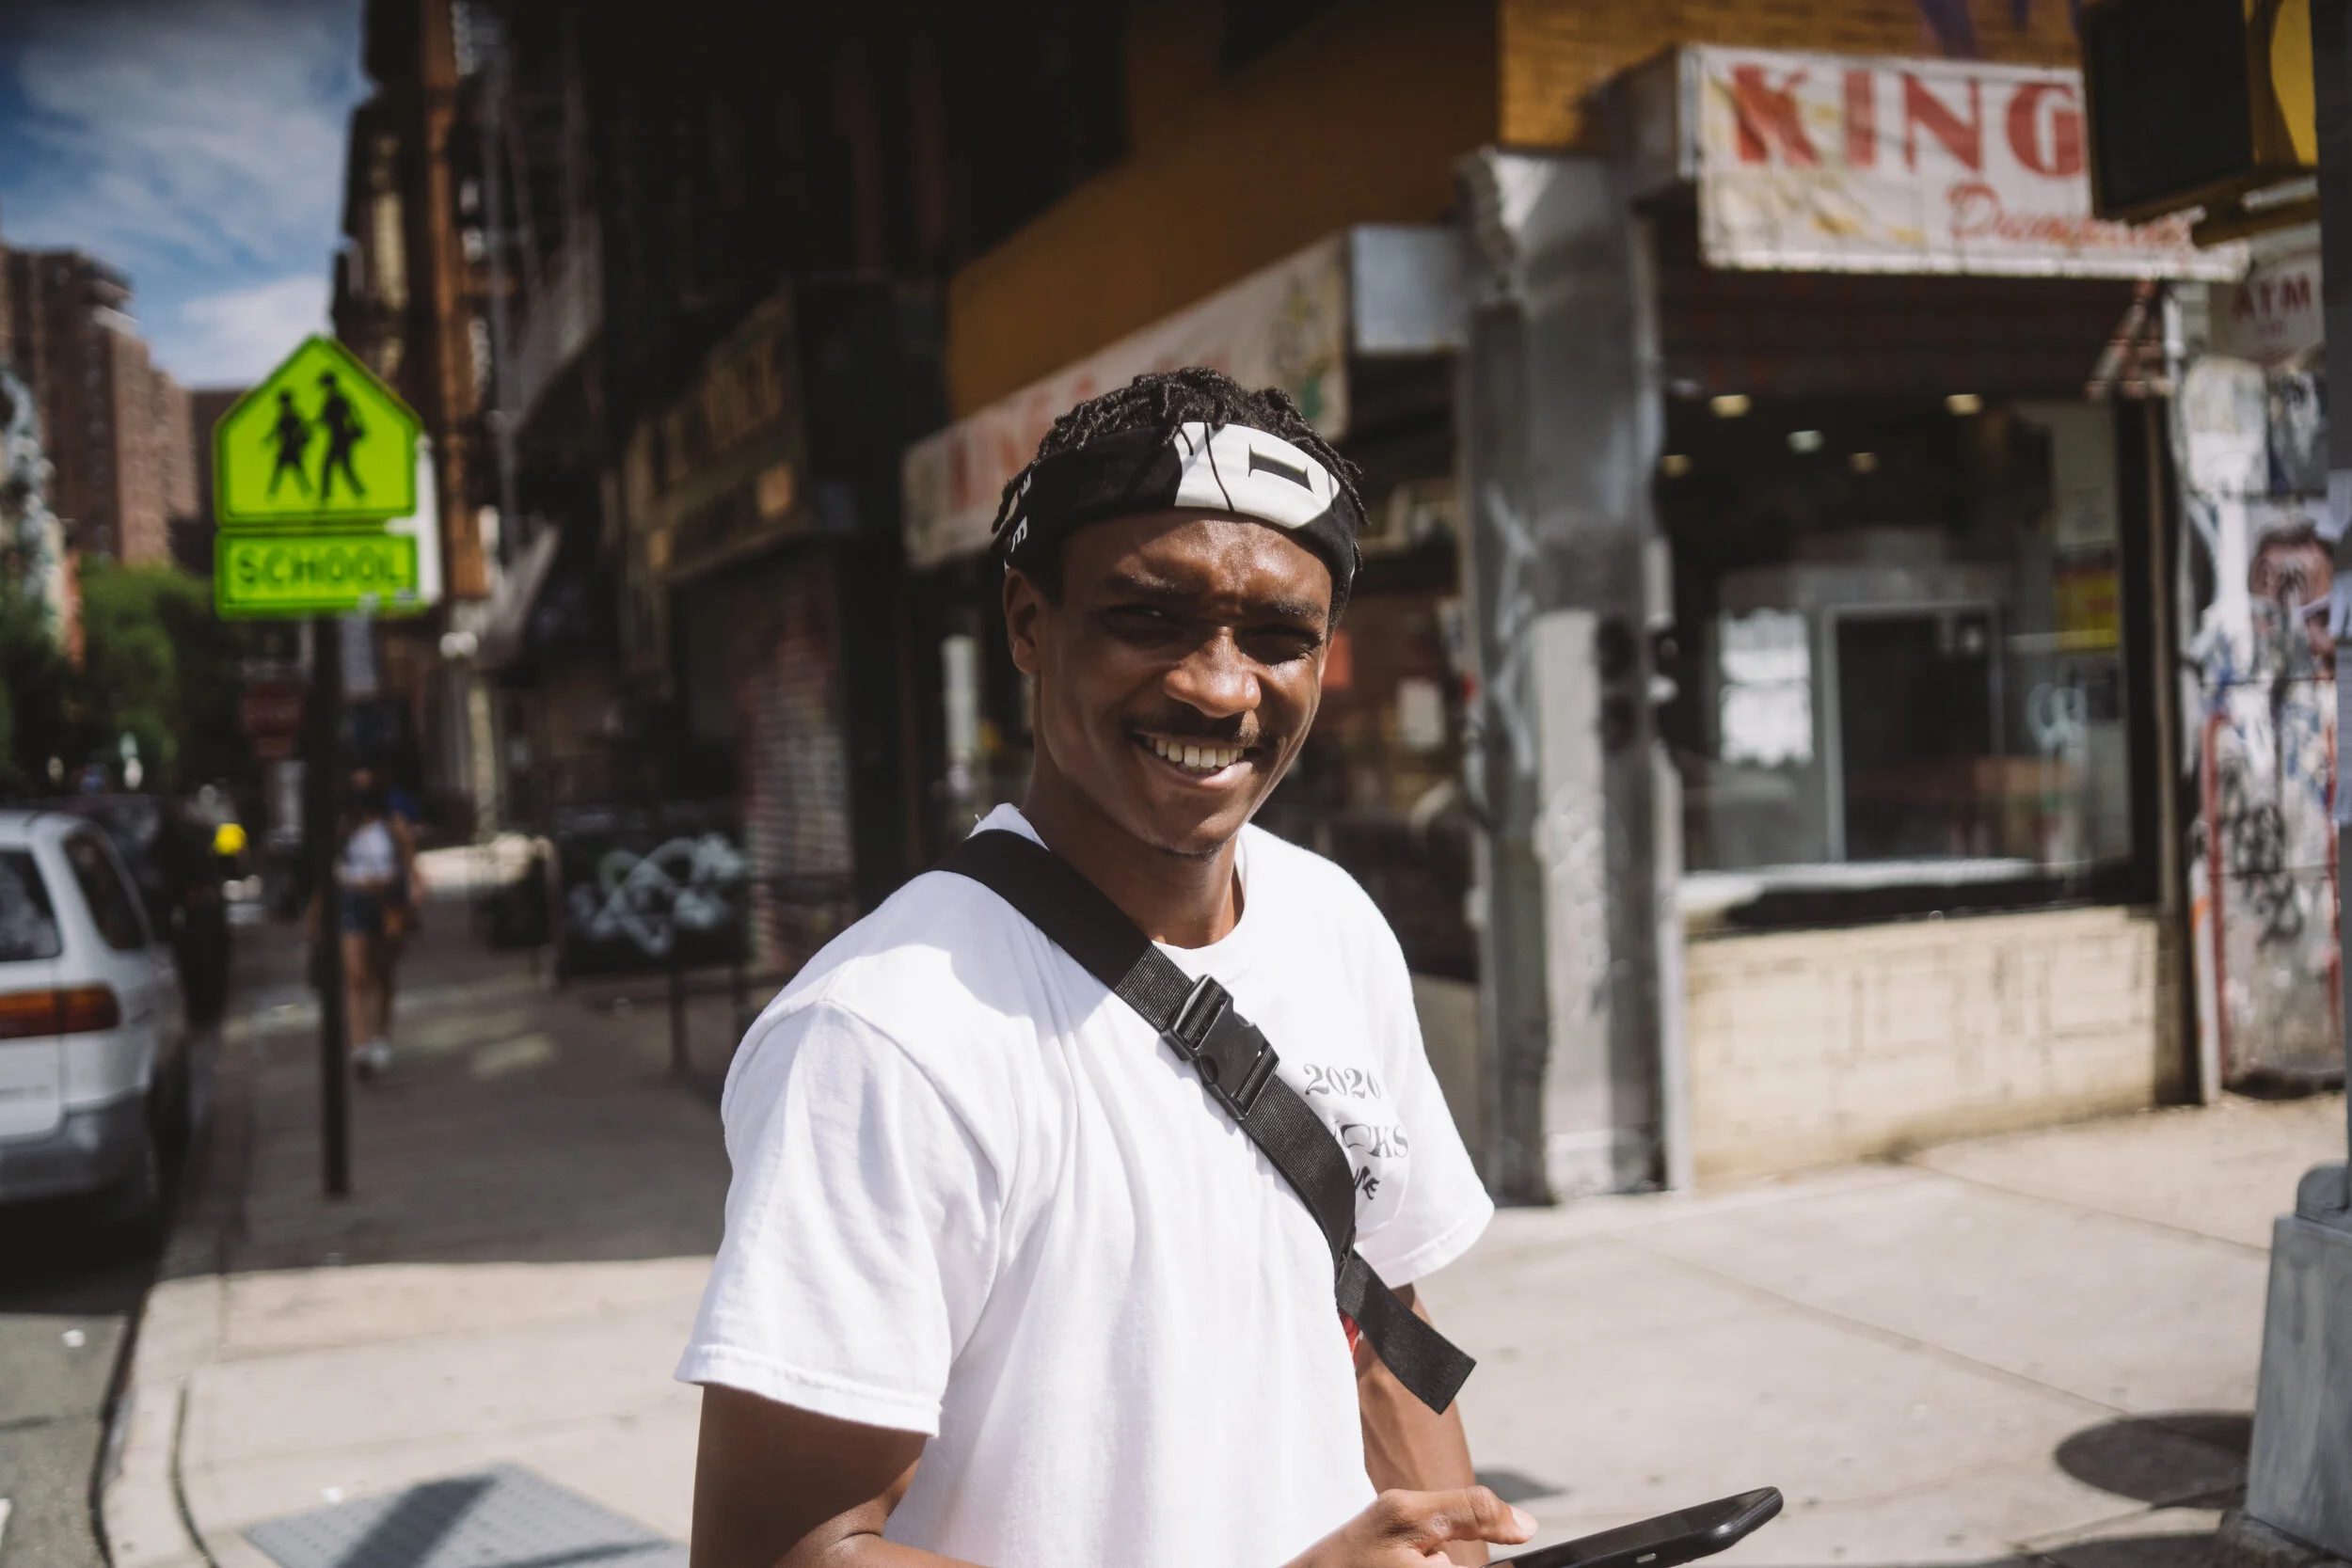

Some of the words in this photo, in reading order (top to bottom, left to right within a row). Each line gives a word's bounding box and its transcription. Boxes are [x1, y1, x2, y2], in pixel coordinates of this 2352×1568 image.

[1733, 63, 2083, 179] KING
[2230, 272, 2312, 320] ATM
[237, 547, 405, 589] SCHOOL
[1303, 1064, 1381, 1100] 2020
